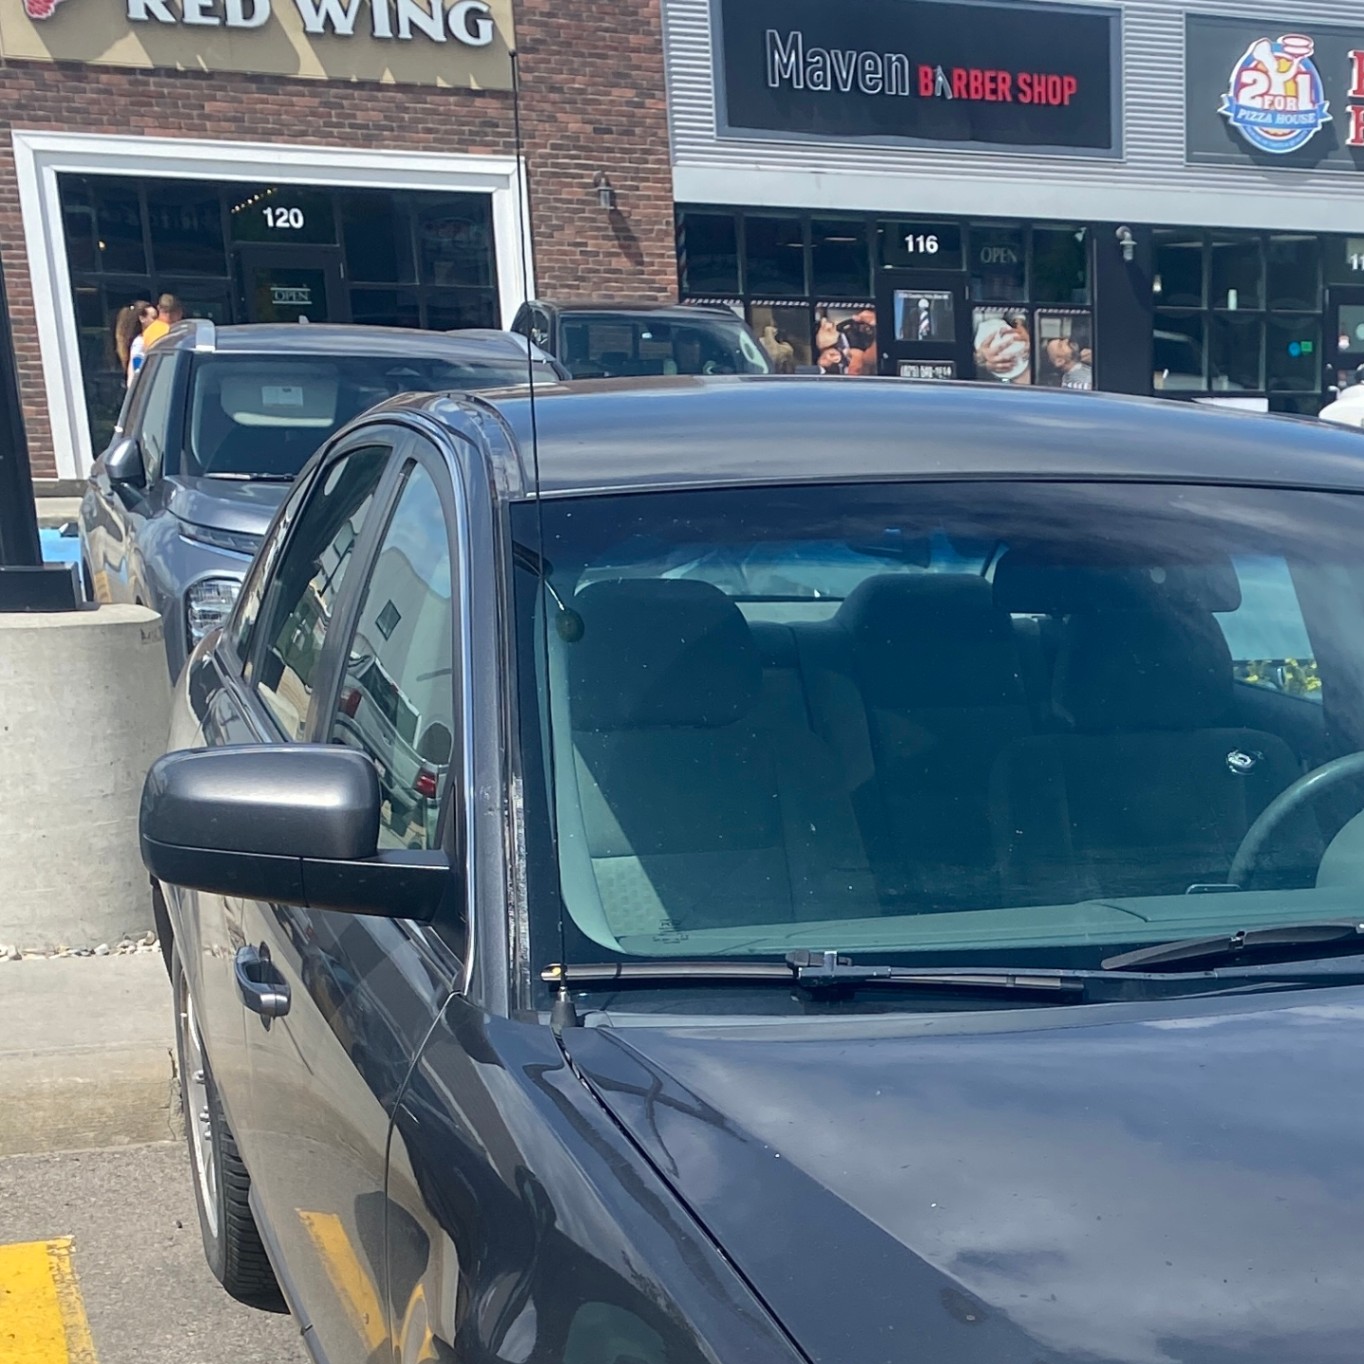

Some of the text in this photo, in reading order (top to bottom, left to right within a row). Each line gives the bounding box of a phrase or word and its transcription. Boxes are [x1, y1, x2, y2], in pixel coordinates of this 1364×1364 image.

[297, 0, 495, 47] WING
[765, 28, 911, 97] Maven
[917, 63, 1079, 107] BARBER SHOP
[1237, 108, 1317, 126] PIZZA HOUSE
[262, 206, 305, 229] 120
[904, 234, 939, 254] 116
[980, 246, 1018, 264] OPEN
